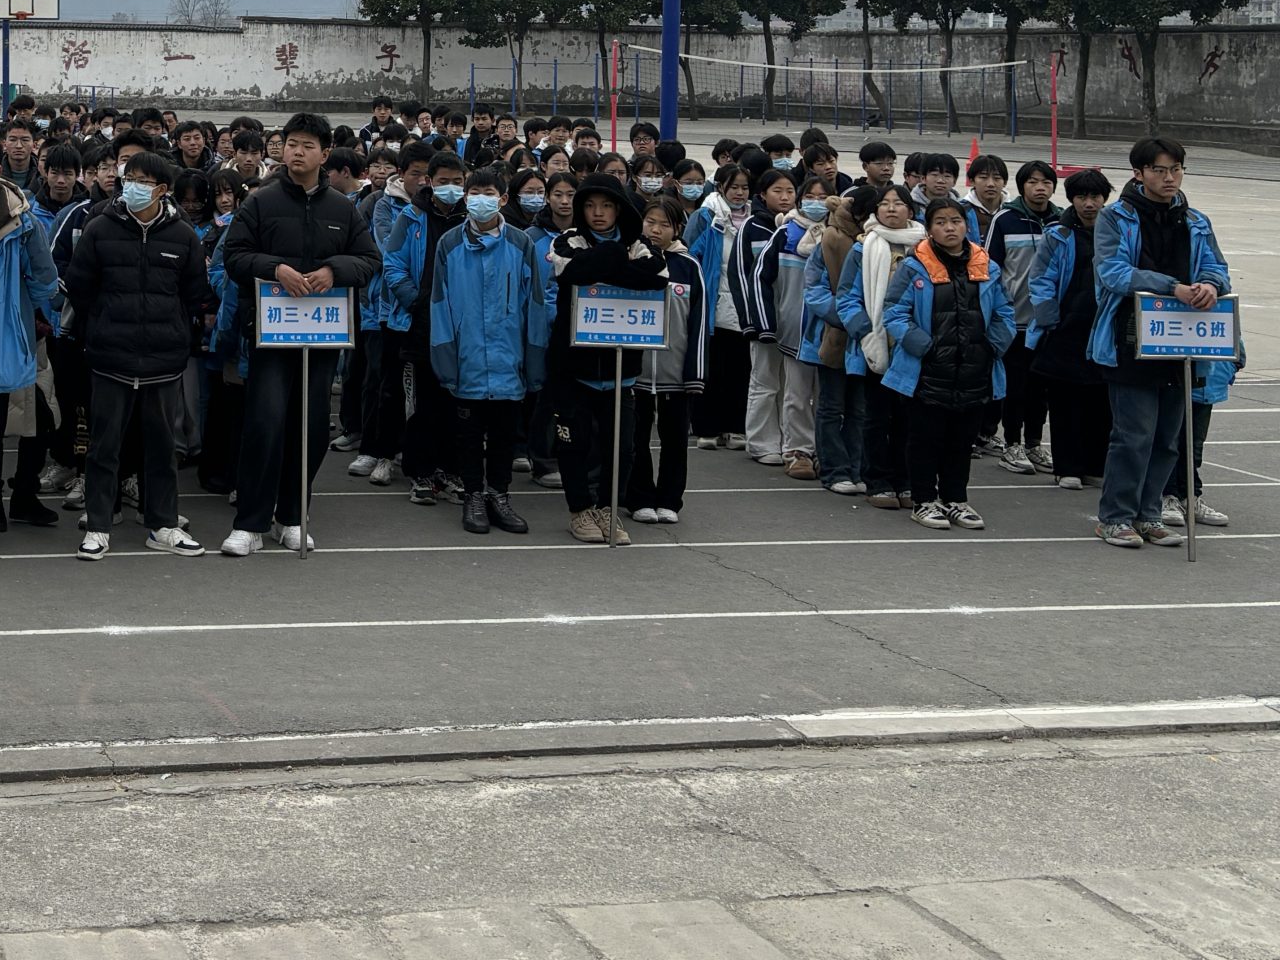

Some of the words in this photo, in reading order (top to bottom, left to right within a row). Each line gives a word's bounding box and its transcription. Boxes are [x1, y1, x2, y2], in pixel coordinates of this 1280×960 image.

[267, 305, 341, 324] 初三·4班
[583, 306, 657, 327] 初三·5班
[1149, 318, 1227, 338] 初三·6班
